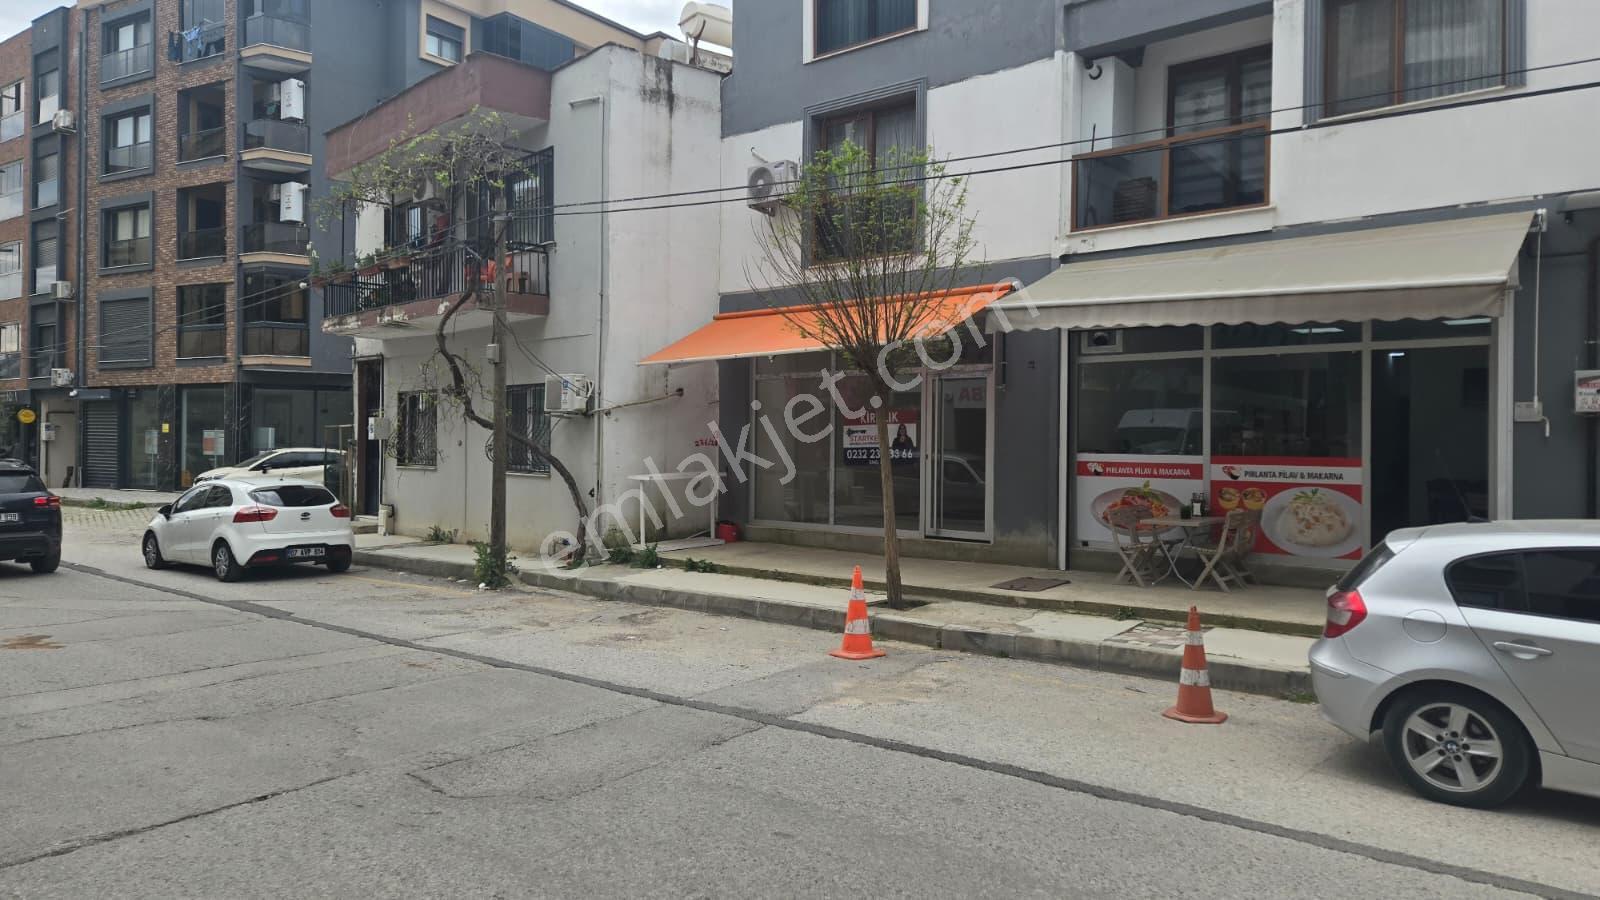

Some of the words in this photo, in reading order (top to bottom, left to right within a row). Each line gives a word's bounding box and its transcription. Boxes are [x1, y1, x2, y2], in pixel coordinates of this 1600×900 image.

[846, 449, 868, 459] 0232
[869, 449, 882, 459] 23
[901, 449, 913, 459] 66
[1134, 466, 1152, 475] PİLAV
[1244, 470, 1276, 479] PIRLANTA
[1278, 470, 1298, 479] PİLAV
[1307, 472, 1344, 481] MAKARNA
